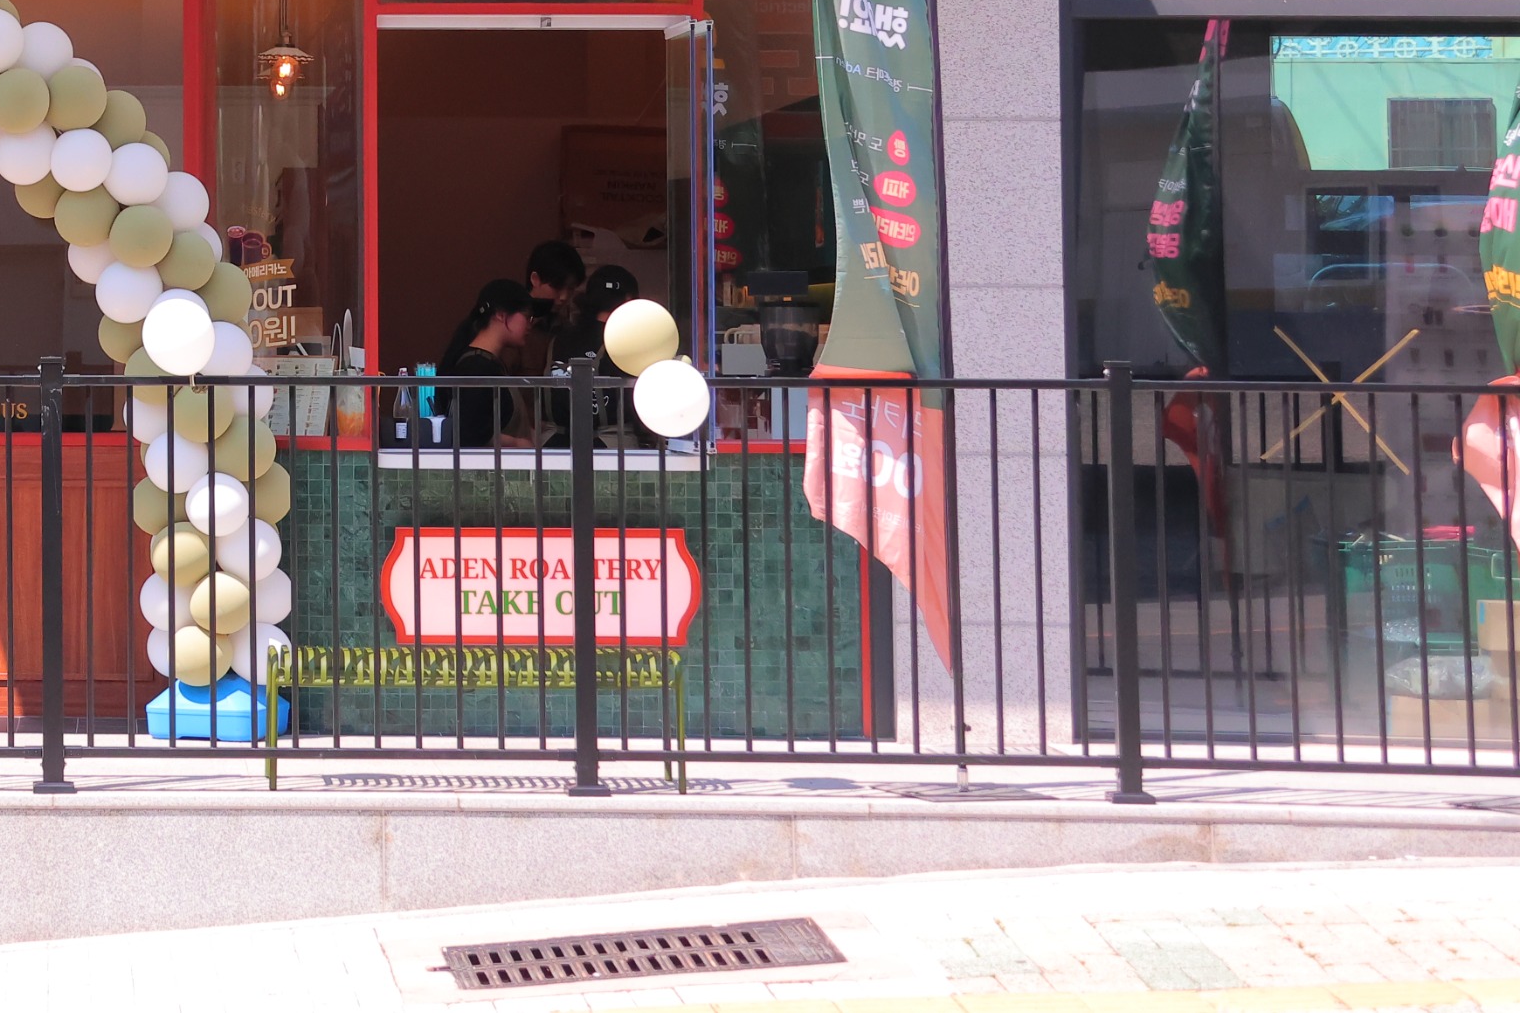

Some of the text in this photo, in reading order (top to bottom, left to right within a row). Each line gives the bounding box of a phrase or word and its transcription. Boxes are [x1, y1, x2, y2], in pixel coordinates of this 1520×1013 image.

[244, 263, 287, 279] 아메리카노
[253, 284, 297, 311] OUT
[419, 558, 662, 580] ADEN ROATERY
[460, 590, 540, 615] TAKE
